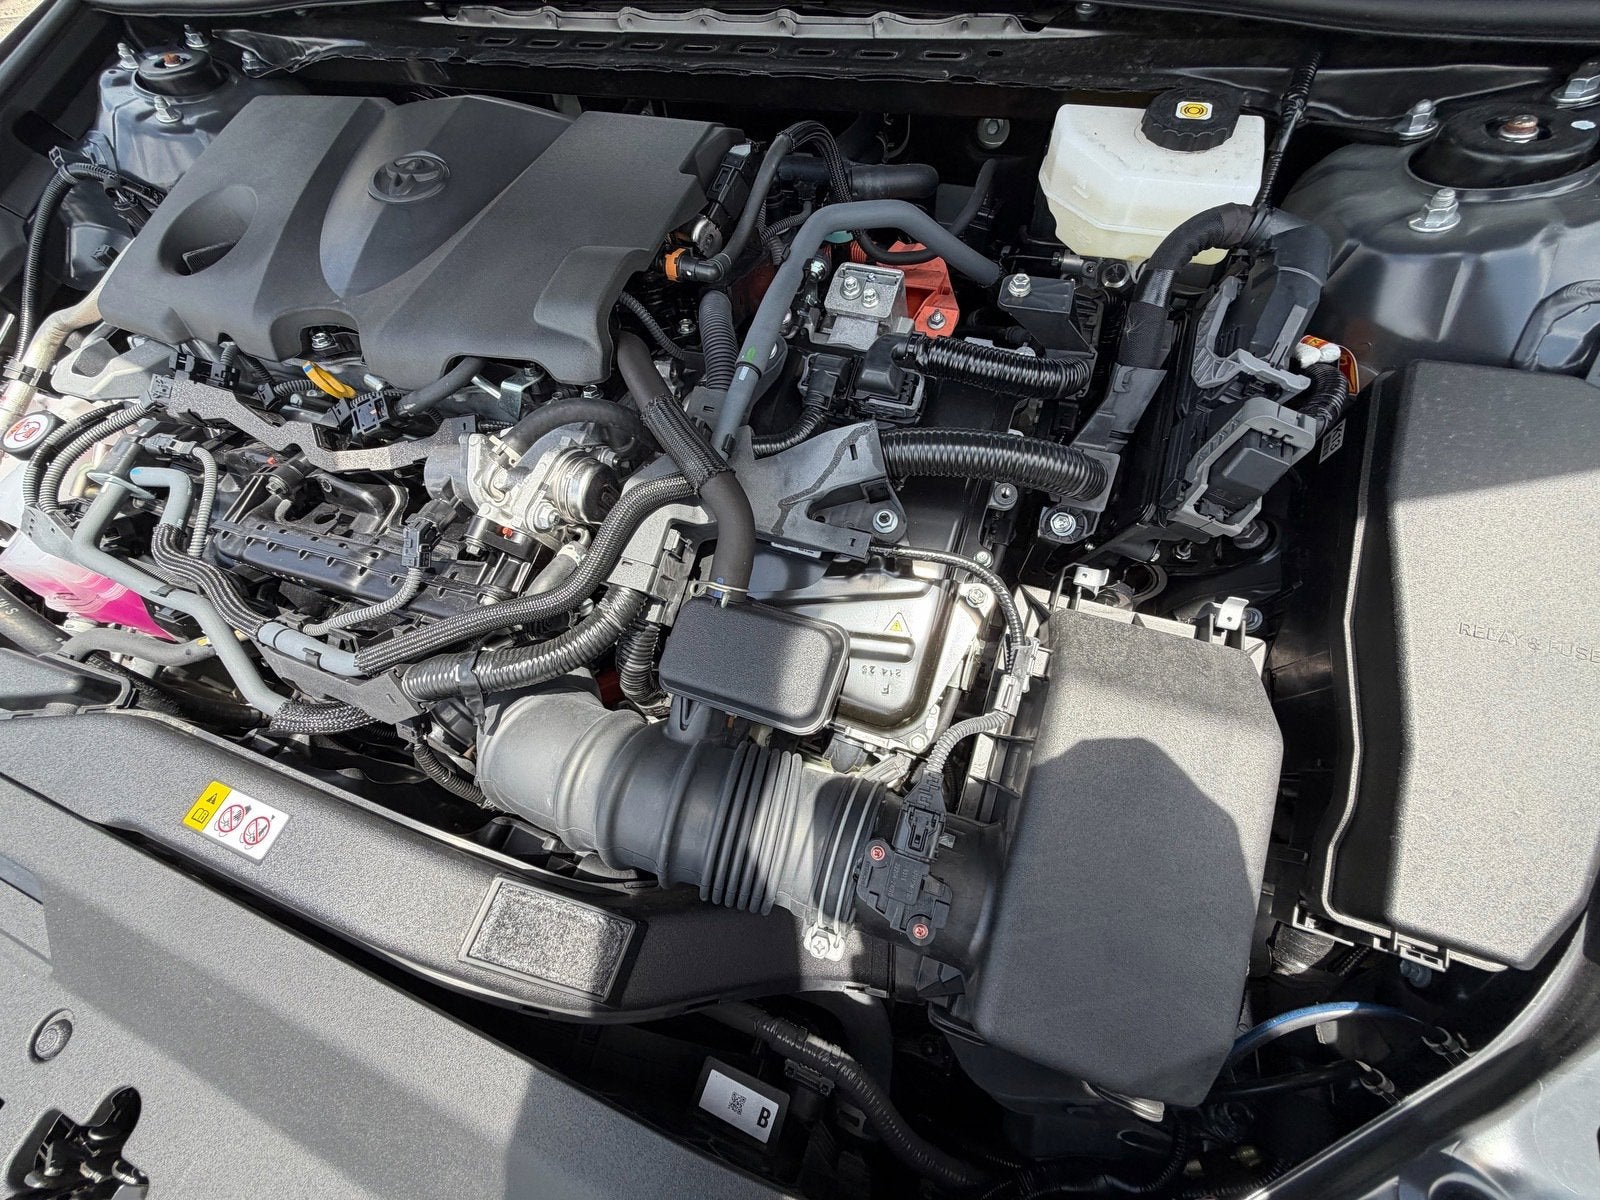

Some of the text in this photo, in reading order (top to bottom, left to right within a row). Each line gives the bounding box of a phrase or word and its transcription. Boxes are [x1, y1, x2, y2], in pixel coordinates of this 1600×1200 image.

[1459, 622, 1600, 664] RELAY & FUSE
[757, 1106, 771, 1129] B
